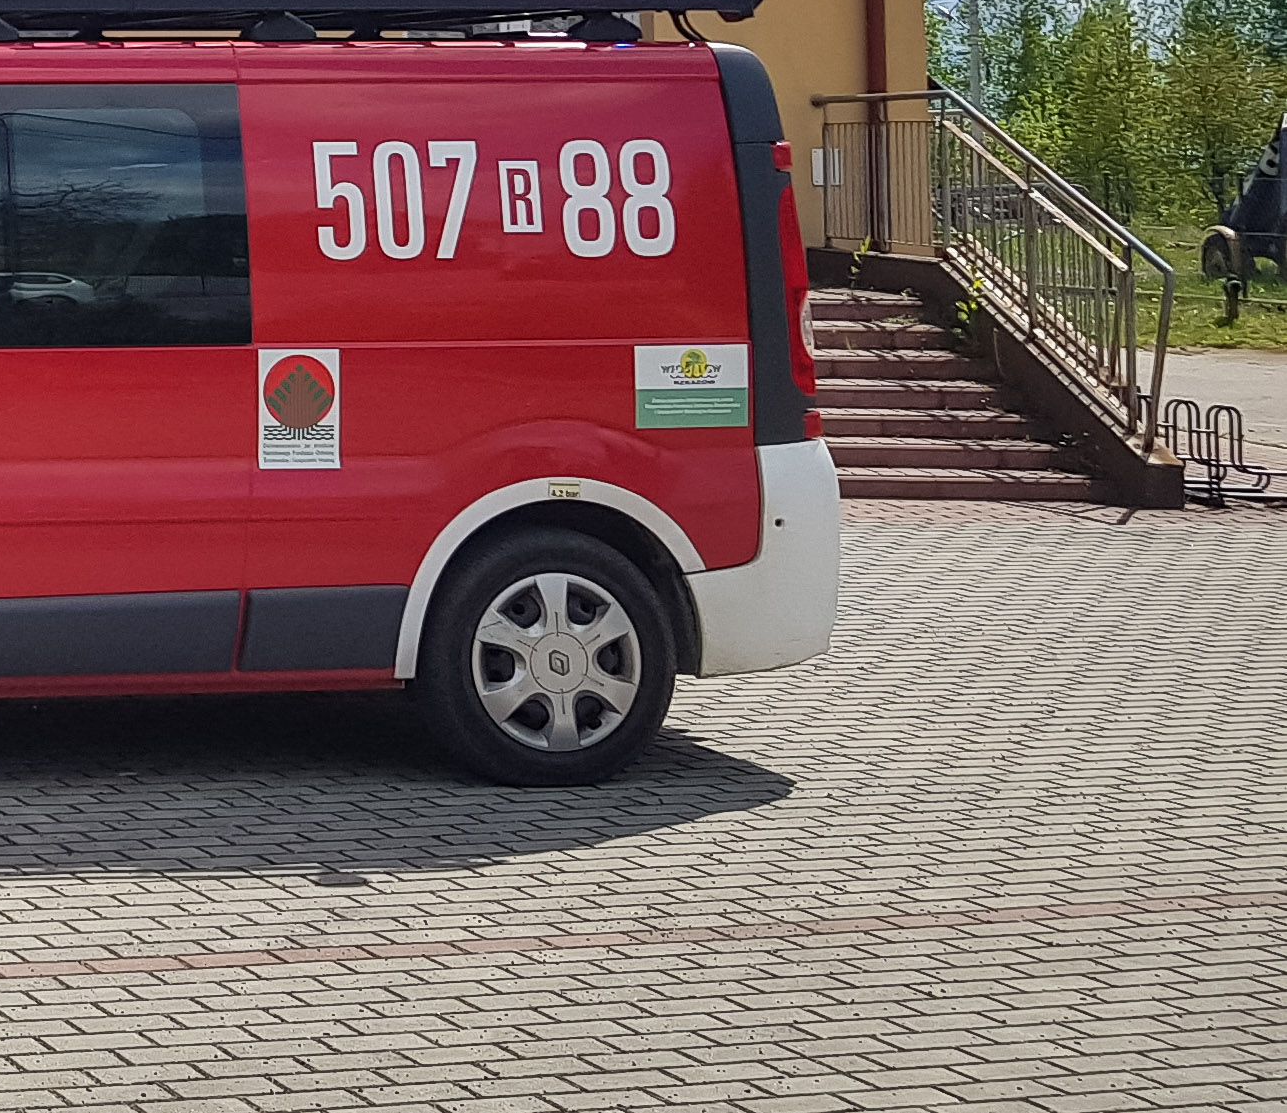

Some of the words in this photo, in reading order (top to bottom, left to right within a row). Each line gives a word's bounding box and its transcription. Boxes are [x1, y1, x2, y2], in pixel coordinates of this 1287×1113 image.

[312, 140, 477, 260] 507
[504, 165, 538, 228] R
[559, 139, 676, 257] 88
